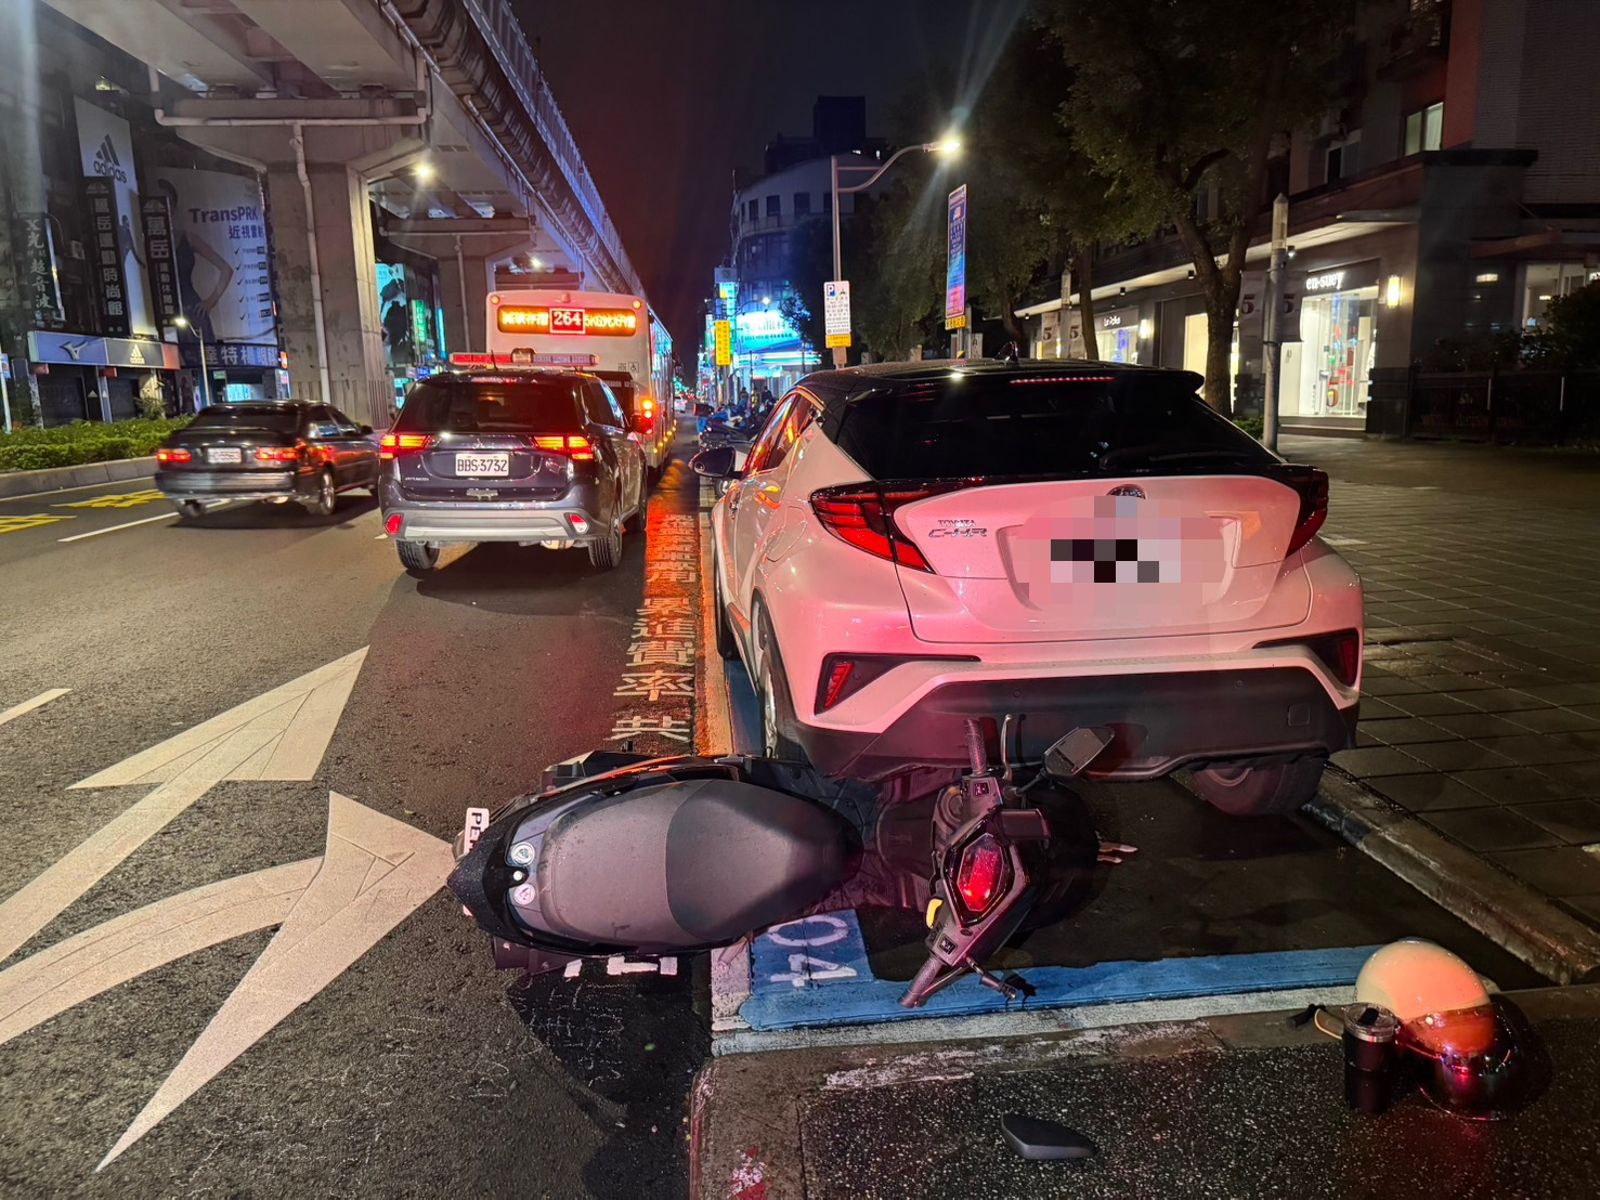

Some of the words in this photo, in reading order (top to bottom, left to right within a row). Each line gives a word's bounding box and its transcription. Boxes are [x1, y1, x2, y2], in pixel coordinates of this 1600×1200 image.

[94, 160, 127, 183] adidas
[188, 206, 258, 224] TransPRK
[1242, 293, 1256, 314] 5
[553, 310, 582, 326] 264
[1043, 327, 1052, 341] 5
[1070, 326, 1079, 339] 5
[928, 527, 988, 538] C-HR
